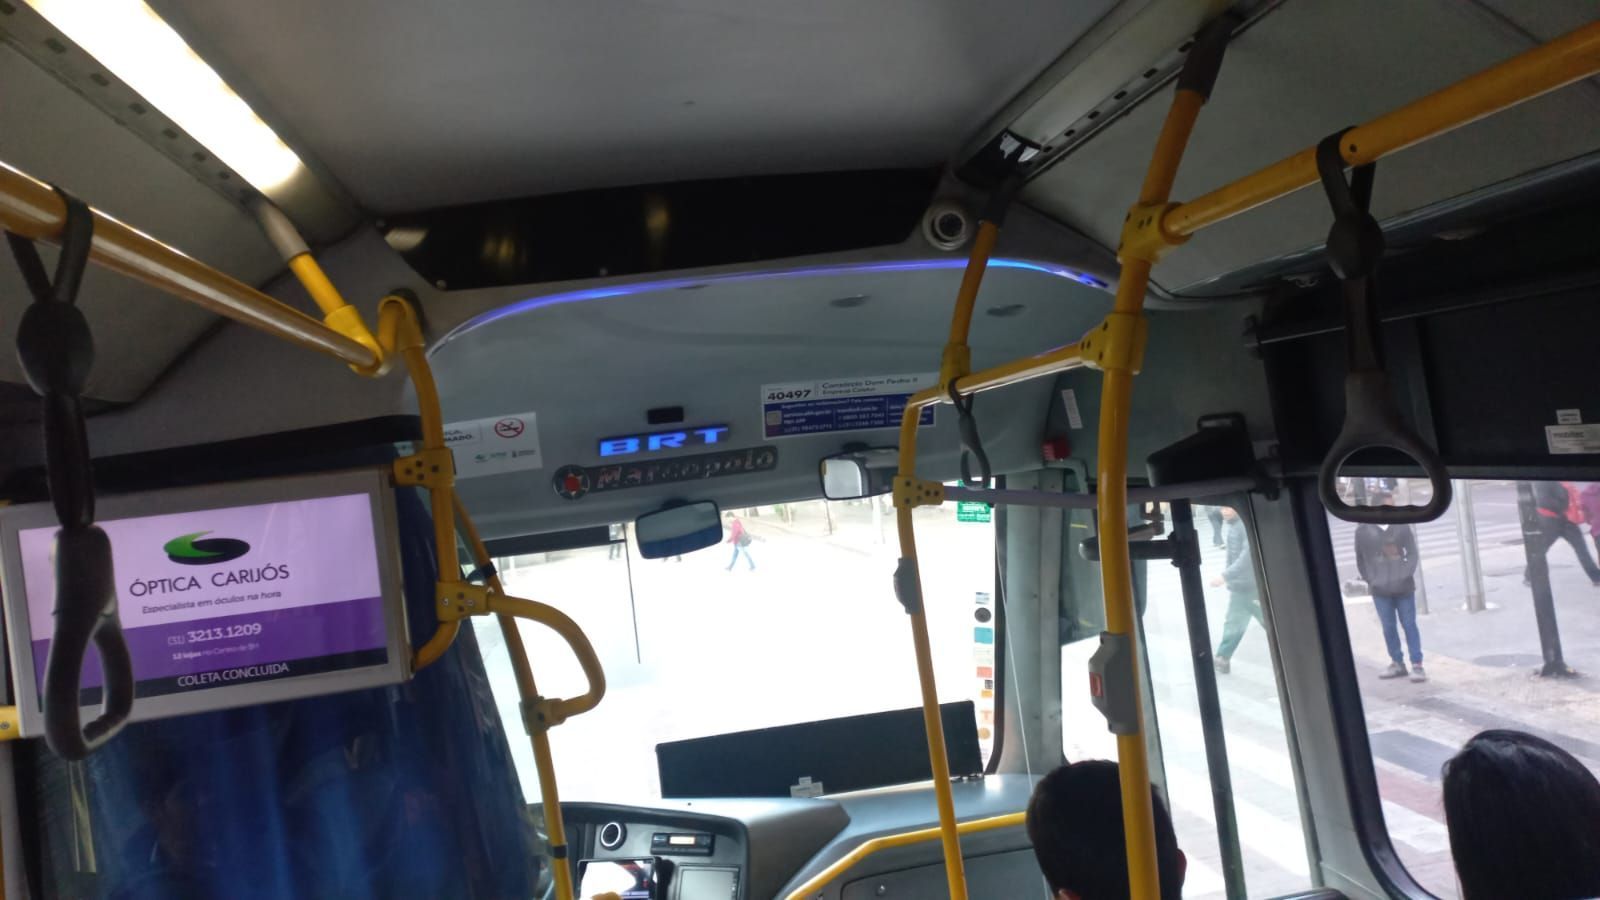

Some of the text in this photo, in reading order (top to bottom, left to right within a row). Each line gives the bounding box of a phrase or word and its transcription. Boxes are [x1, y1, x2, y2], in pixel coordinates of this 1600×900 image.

[767, 389, 812, 401] 40497
[600, 426, 729, 457] BRT
[597, 448, 774, 488] Marcopolo
[129, 563, 290, 597] ÓPTICA CARIJÓS
[142, 600, 195, 614] Especialista
[215, 595, 245, 605] óculos
[247, 593, 259, 601] na
[260, 591, 282, 600] hora
[187, 622, 262, 643] 3213.1209
[177, 671, 222, 687] COLETA
